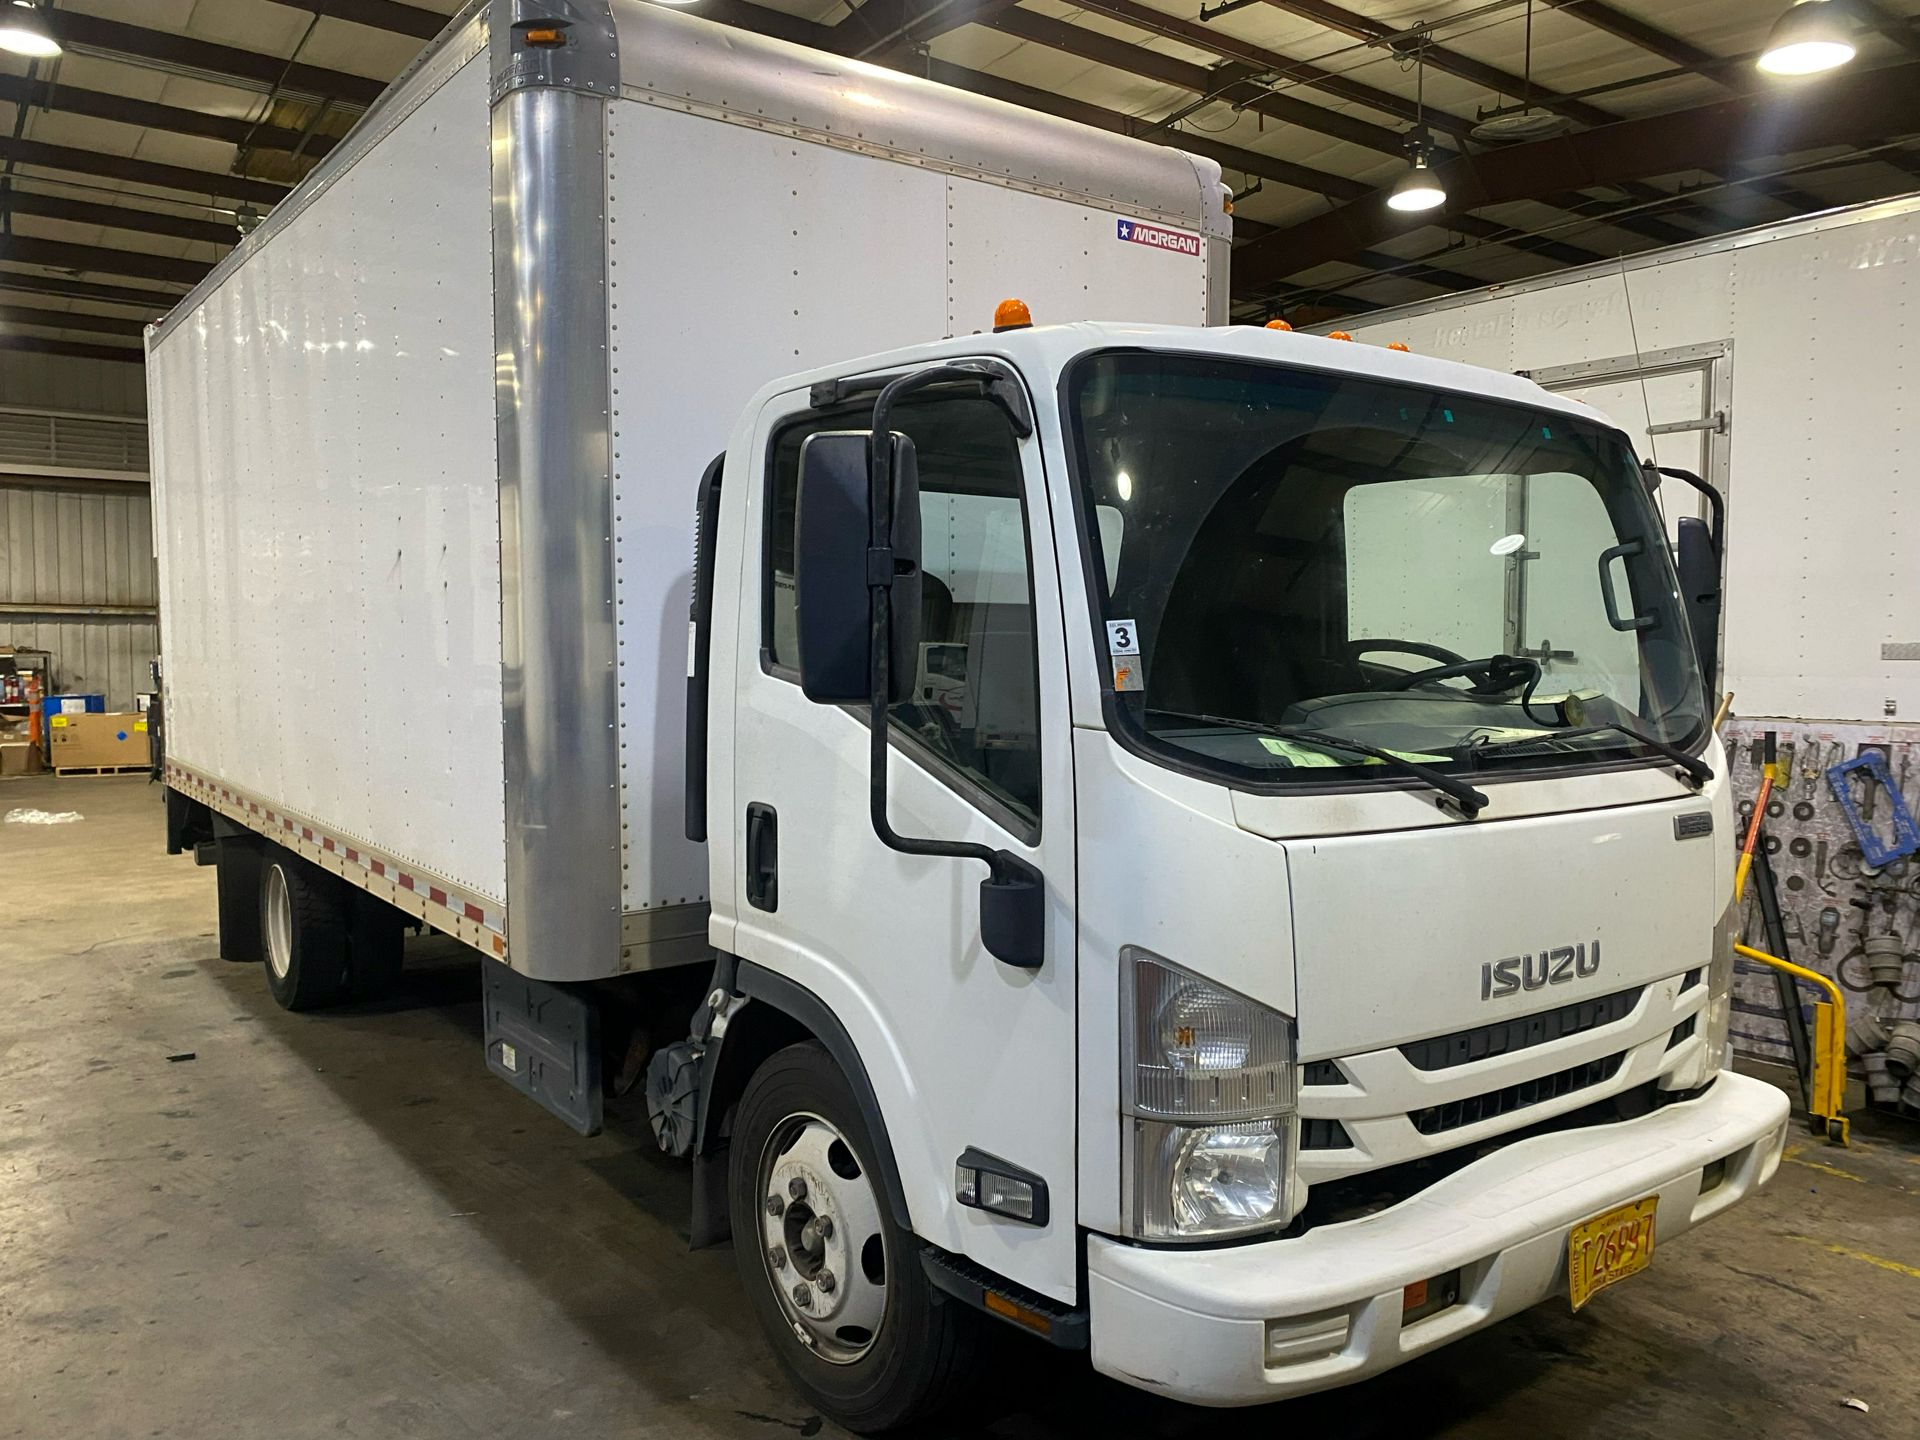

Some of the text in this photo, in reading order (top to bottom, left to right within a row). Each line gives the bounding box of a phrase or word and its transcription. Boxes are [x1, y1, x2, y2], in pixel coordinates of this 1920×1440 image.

[1132, 226, 1197, 253] MORGAN
[1115, 627, 1131, 648] 3
[1481, 939, 1600, 1001] ISUZU
